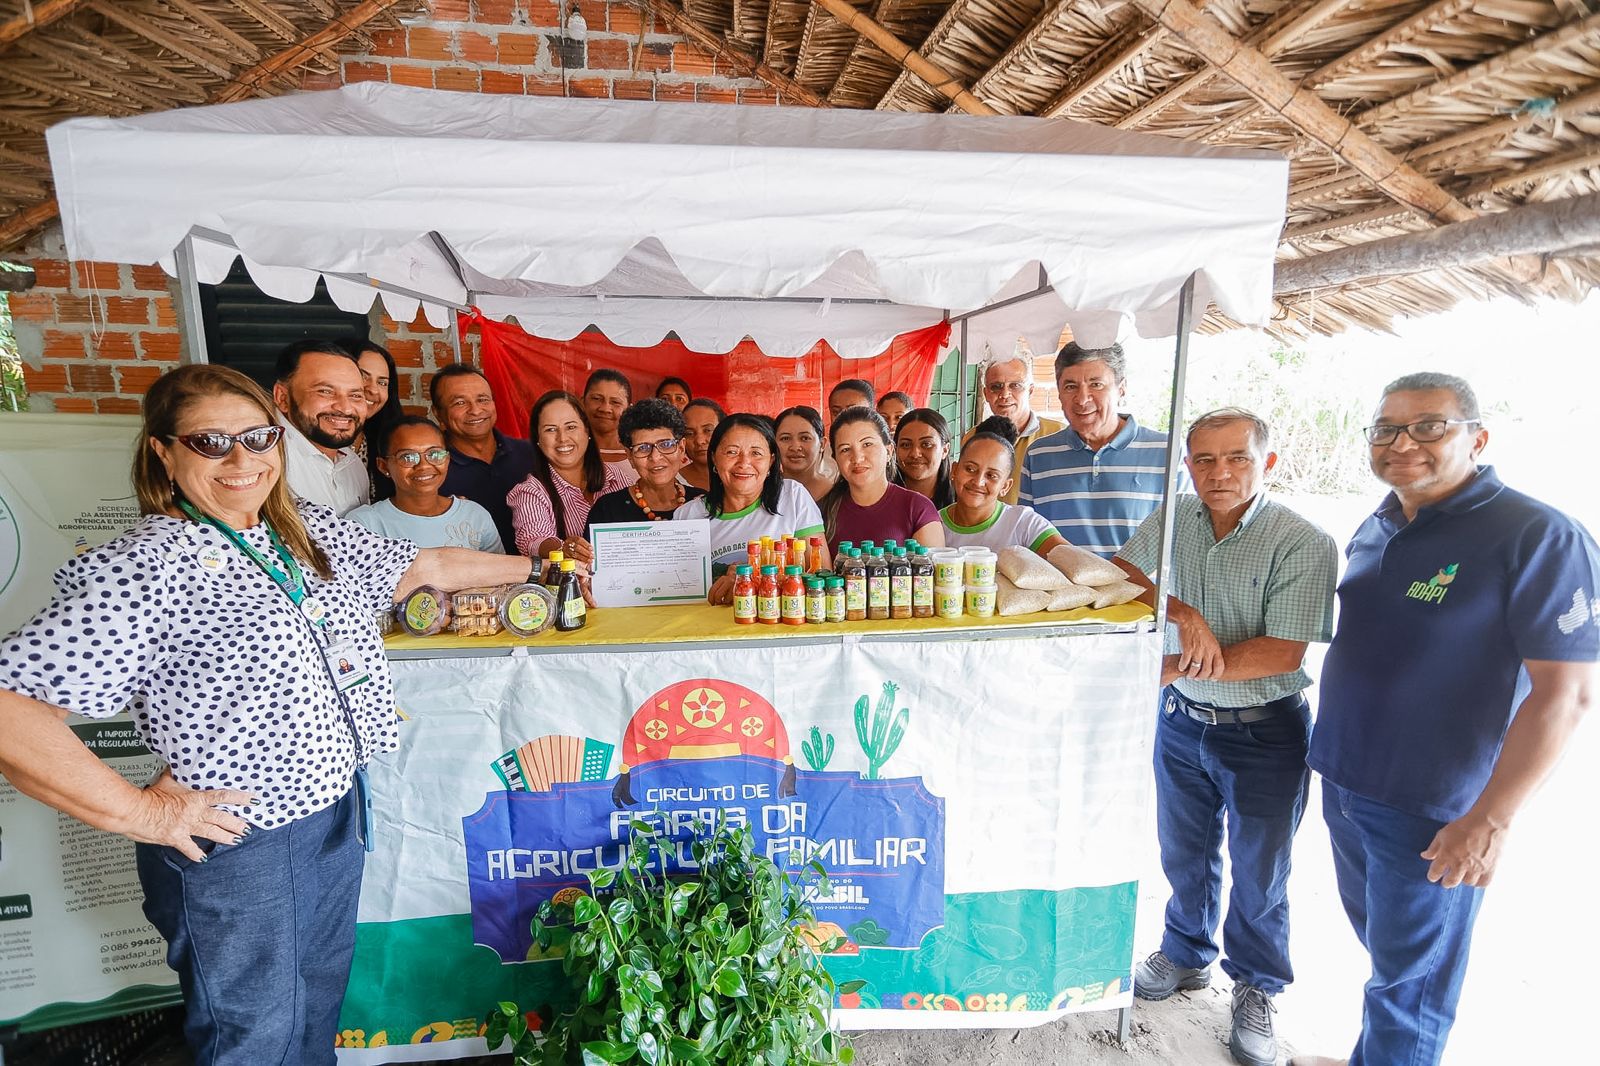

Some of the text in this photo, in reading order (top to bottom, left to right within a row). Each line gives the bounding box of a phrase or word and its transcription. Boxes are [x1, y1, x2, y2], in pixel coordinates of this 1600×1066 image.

[622, 531, 661, 539] CERTIFICADO
[732, 542, 746, 550] DAS
[1405, 580, 1449, 604] ADAPI
[96, 729, 140, 738] A IMPORTA
[85, 738, 146, 748] DA REGULAMEN
[646, 783, 770, 802] CIRCUITO DE
[609, 802, 808, 839] FEIRAS DA
[80, 839, 113, 849] DECRETO
[765, 836, 927, 868] FAMILIAR
[62, 857, 97, 868] dimentos
[98, 855, 115, 863] para
[108, 881, 135, 890] Decreto
[788, 885, 870, 904] RASIL
[4, 904, 29, 915] ATIVA
[110, 942, 129, 952] 086
[112, 947, 161, 964] @adapi_pi
